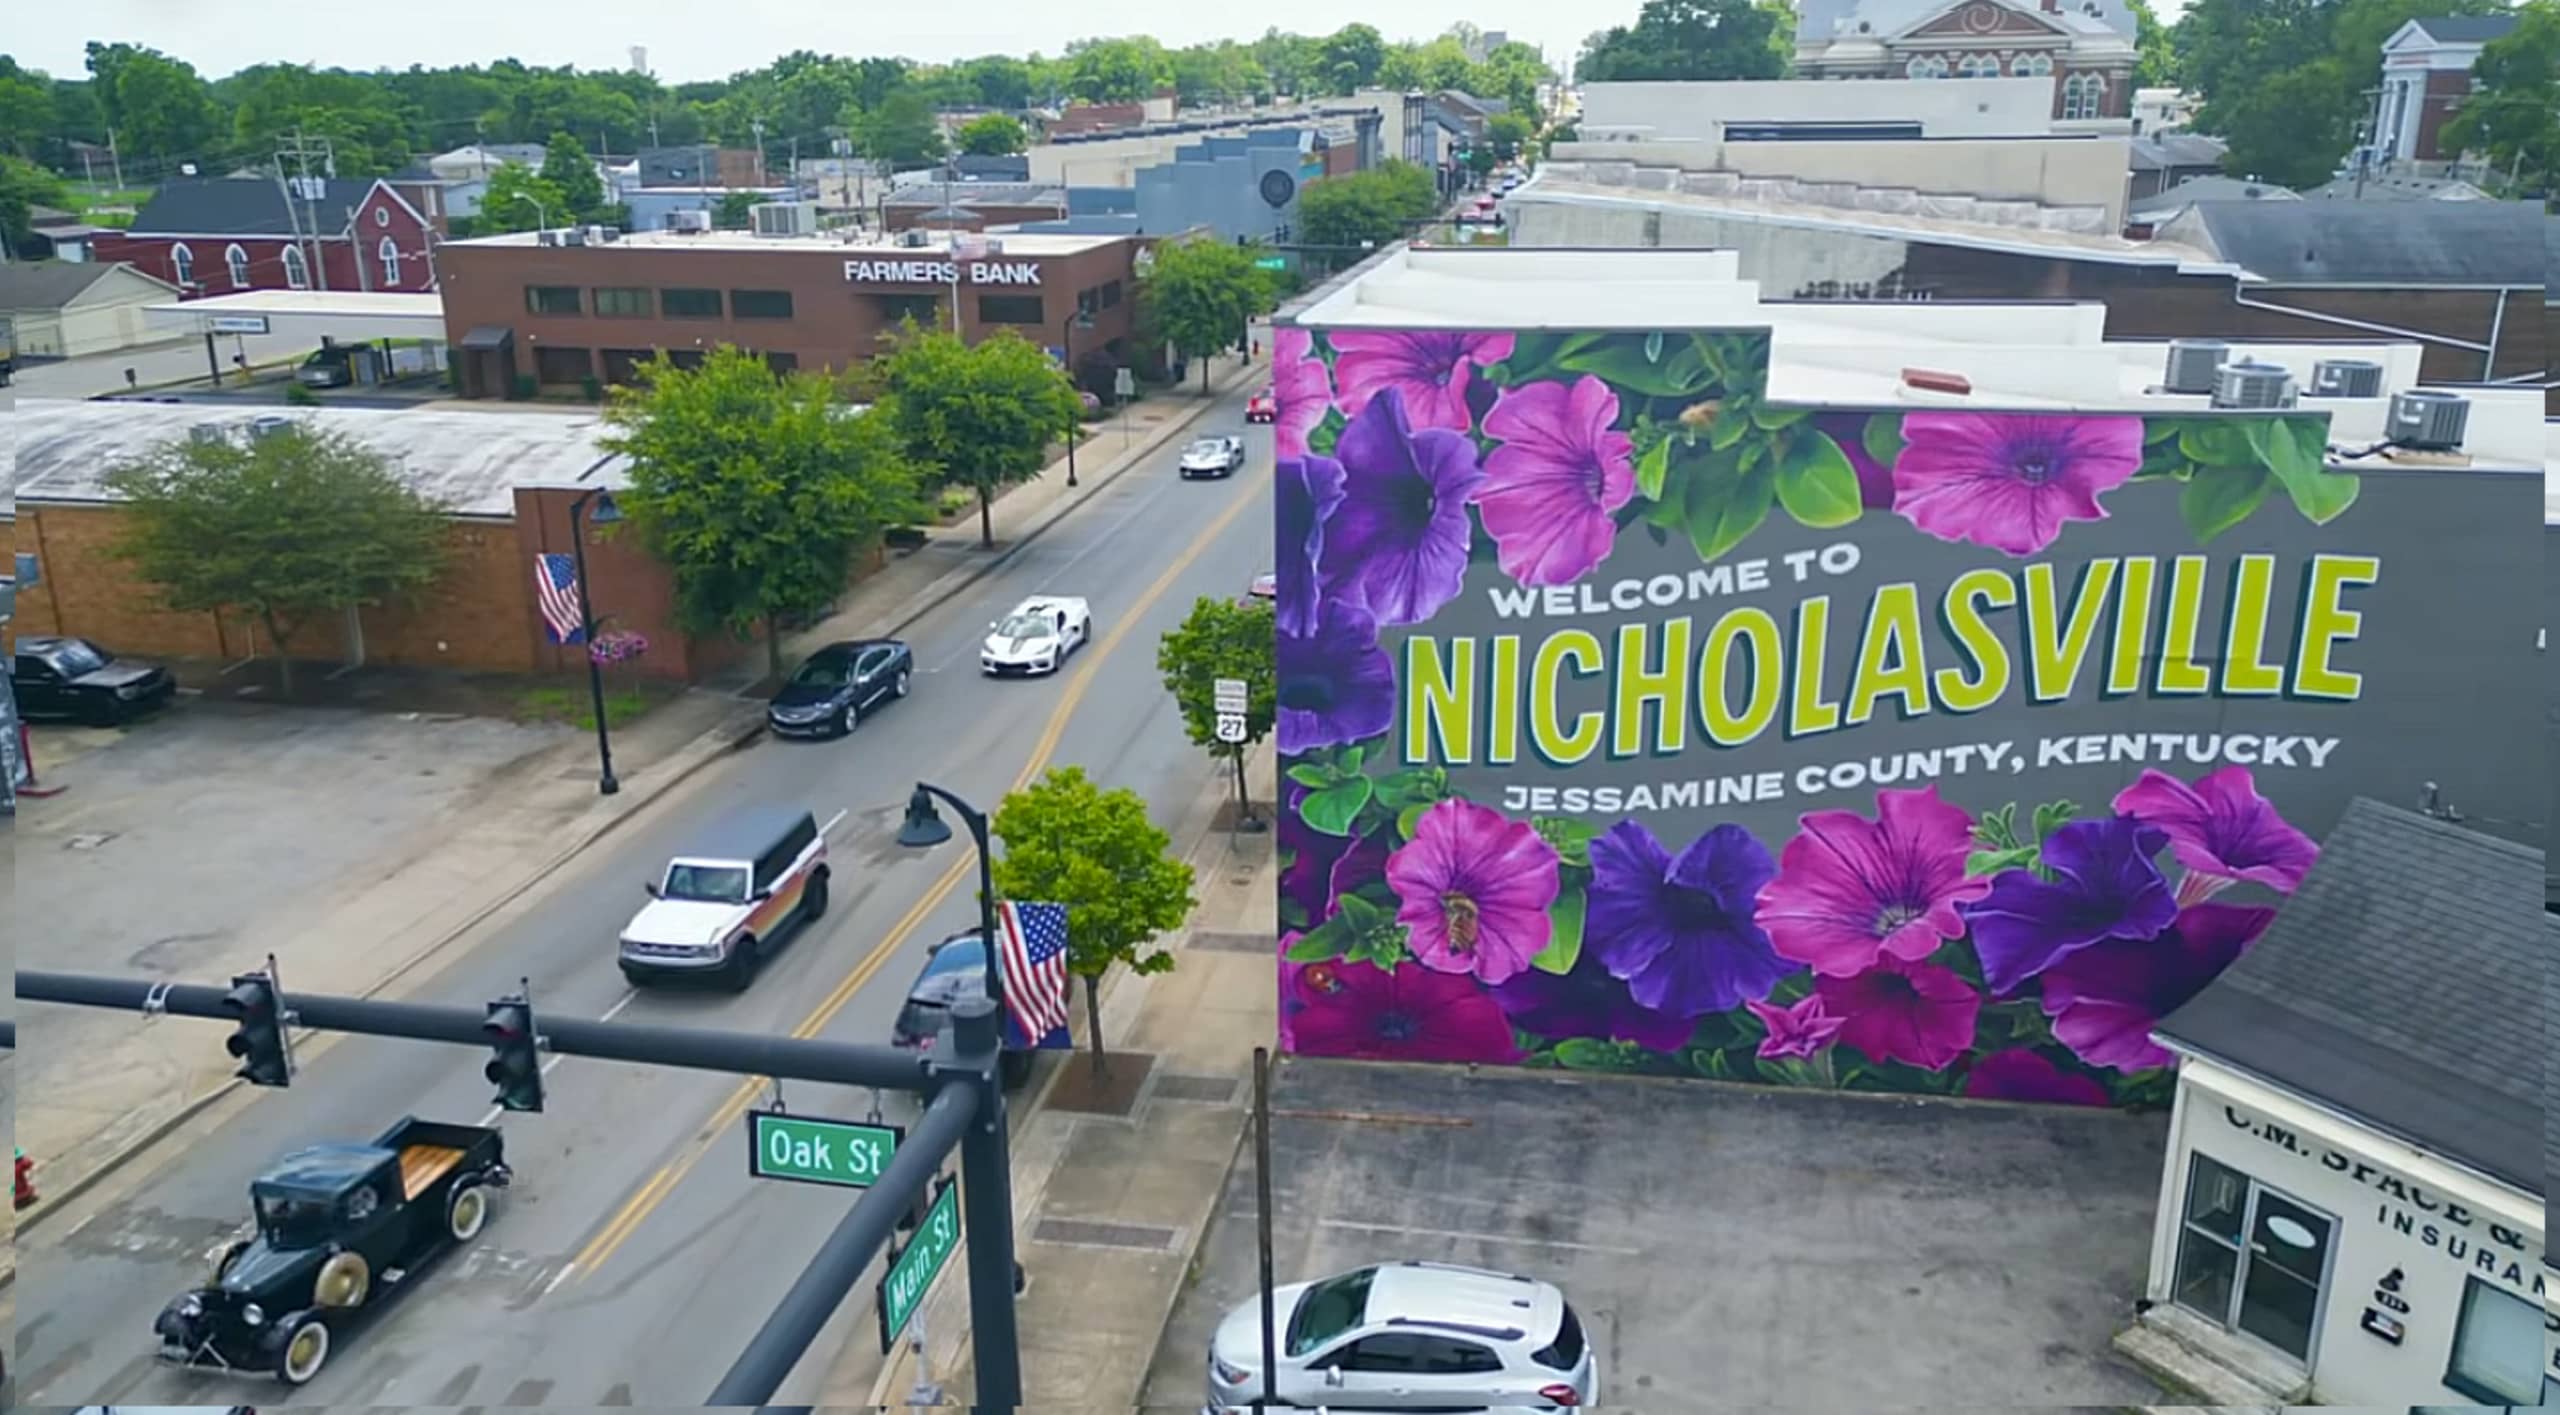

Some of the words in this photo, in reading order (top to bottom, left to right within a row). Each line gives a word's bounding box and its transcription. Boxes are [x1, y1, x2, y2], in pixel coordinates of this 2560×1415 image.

[844, 260, 959, 283] FARMERS
[970, 262, 1041, 284] BANK
[1487, 558, 1771, 618] WELCOME
[1784, 541, 1862, 583] TO
[1402, 553, 2381, 766] NICHOLASVILLE
[1221, 719, 1242, 737] 27
[1502, 771, 1786, 813] JESSAMINE
[1796, 741, 2026, 794] COUNTY,
[2036, 733, 2341, 769] KENTUCKY
[770, 1129, 832, 1171] Oak
[848, 1139, 882, 1175] St
[892, 1245, 931, 1319] Main
[933, 1208, 951, 1252] St
